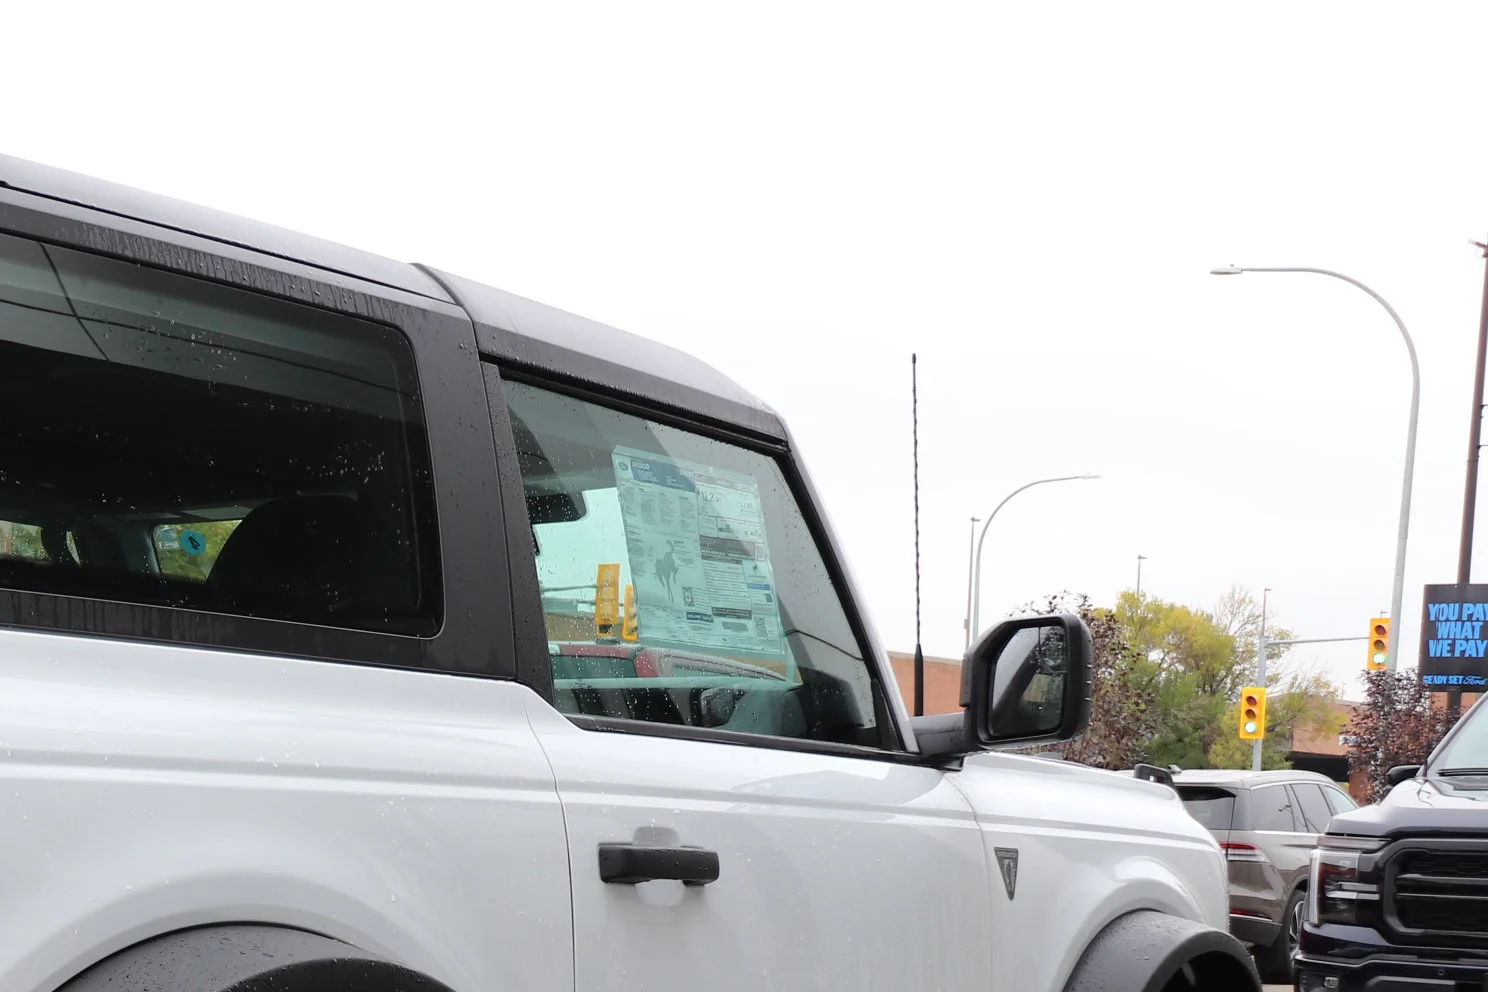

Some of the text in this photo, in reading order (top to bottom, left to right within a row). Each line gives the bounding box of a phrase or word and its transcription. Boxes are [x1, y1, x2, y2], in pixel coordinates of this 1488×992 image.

[1428, 603, 1460, 621] YOU
[1435, 621, 1483, 639] WHAT
[1428, 639, 1488, 658] WE PAY
[1448, 675, 1463, 685] SET
[1463, 675, 1487, 685] Ford
